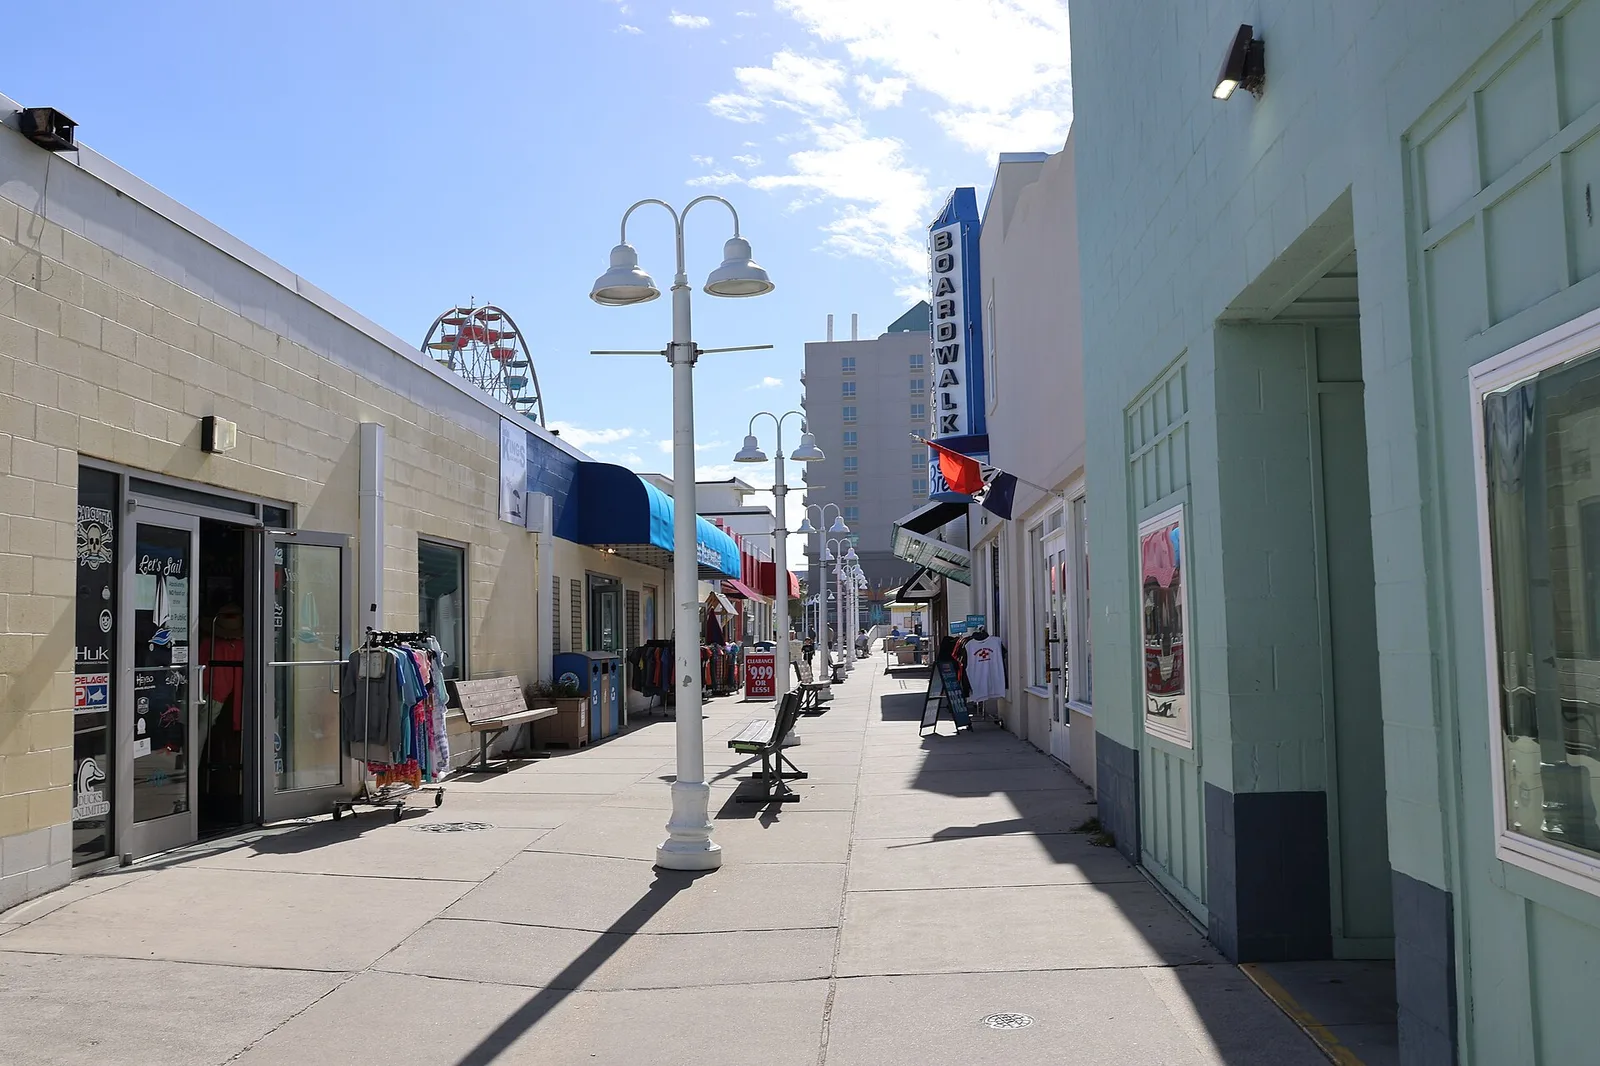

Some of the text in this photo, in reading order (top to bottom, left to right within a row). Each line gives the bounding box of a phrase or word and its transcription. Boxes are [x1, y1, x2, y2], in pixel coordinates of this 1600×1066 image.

[934, 231, 959, 433] BOARDWALK
[139, 555, 183, 576] Let's Sail
[75, 646, 109, 660] Huk
[748, 665, 773, 680] $9.99
[75, 676, 108, 685] PELAGIC
[78, 793, 102, 806] DUCKS
[73, 802, 109, 820] NLIMITED
